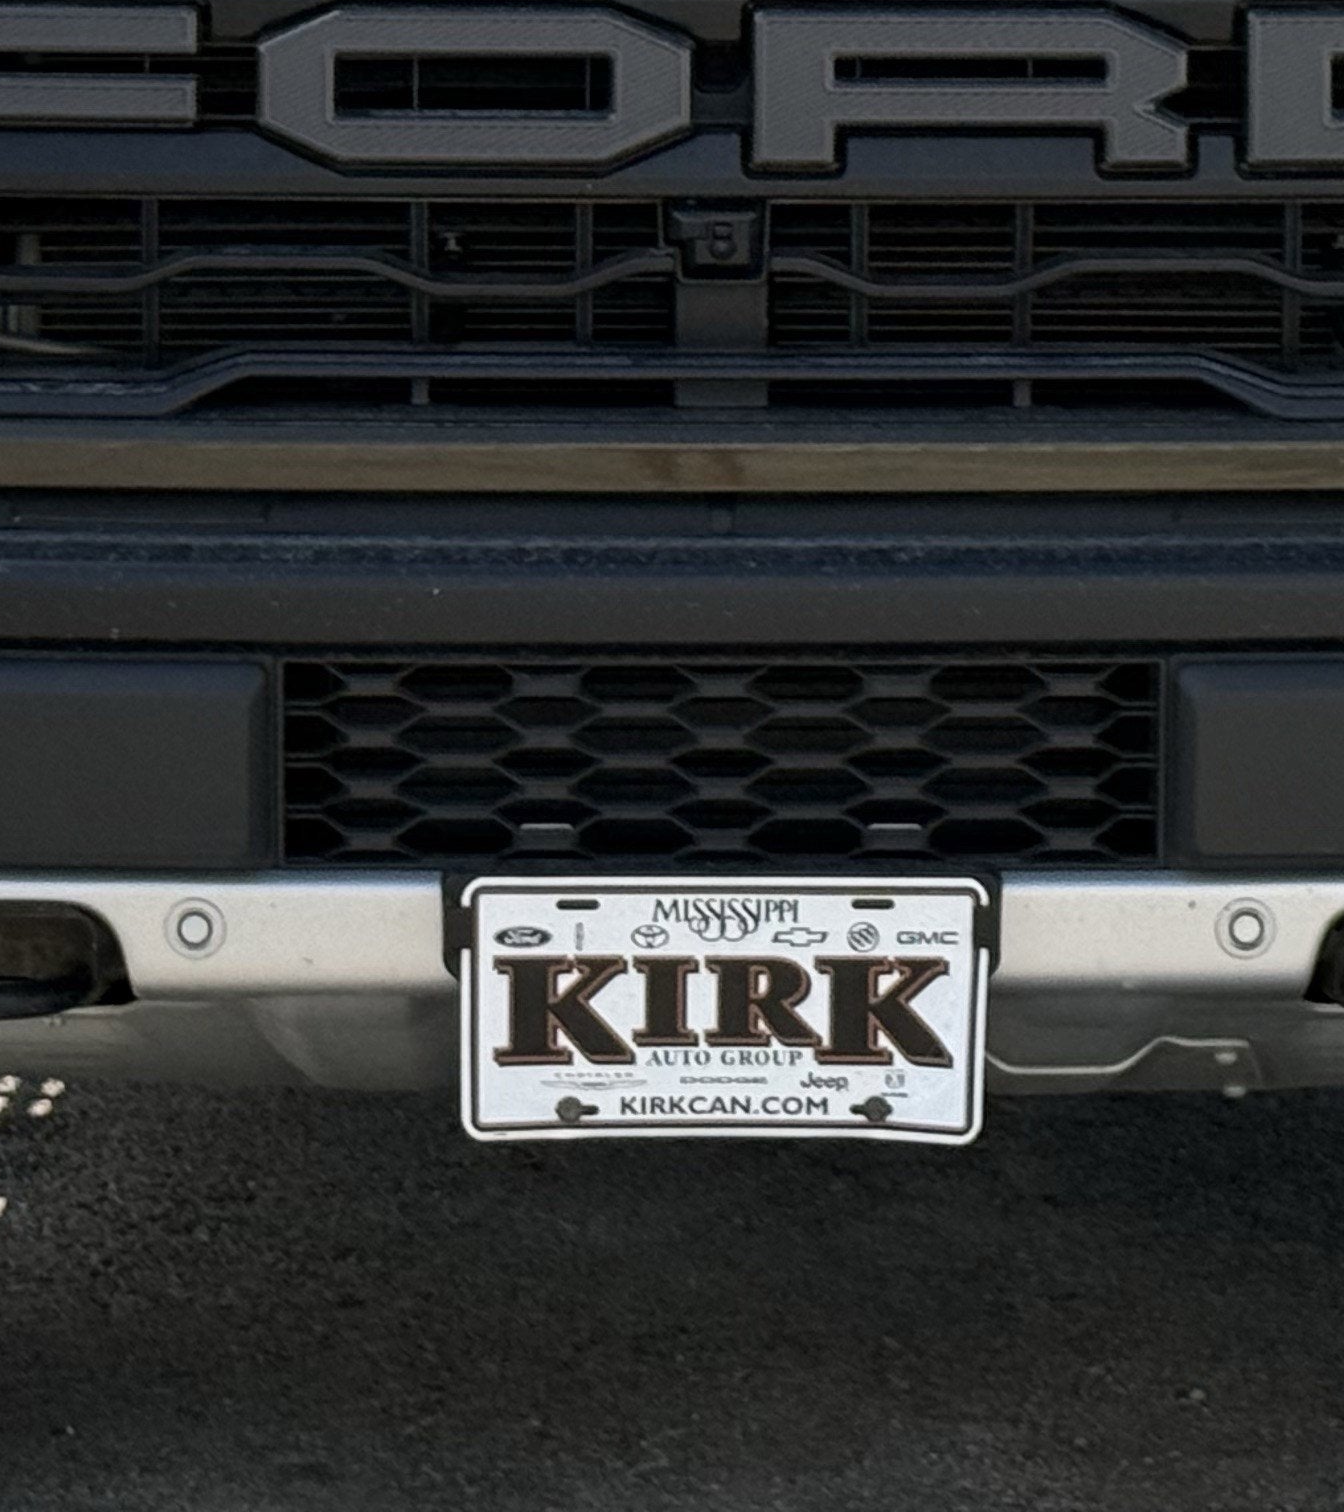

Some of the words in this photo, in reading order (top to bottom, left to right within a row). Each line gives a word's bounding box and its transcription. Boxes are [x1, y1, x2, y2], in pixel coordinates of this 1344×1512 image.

[652, 898, 799, 942] MISSISSIPPI
[896, 930, 959, 945] GMC
[493, 955, 953, 1068] KIRK
[646, 1049, 711, 1066] AUTO
[720, 1049, 803, 1066] GROUP
[799, 1071, 849, 1091] Jeep
[619, 1095, 829, 1116] KIRKCAN.COM
